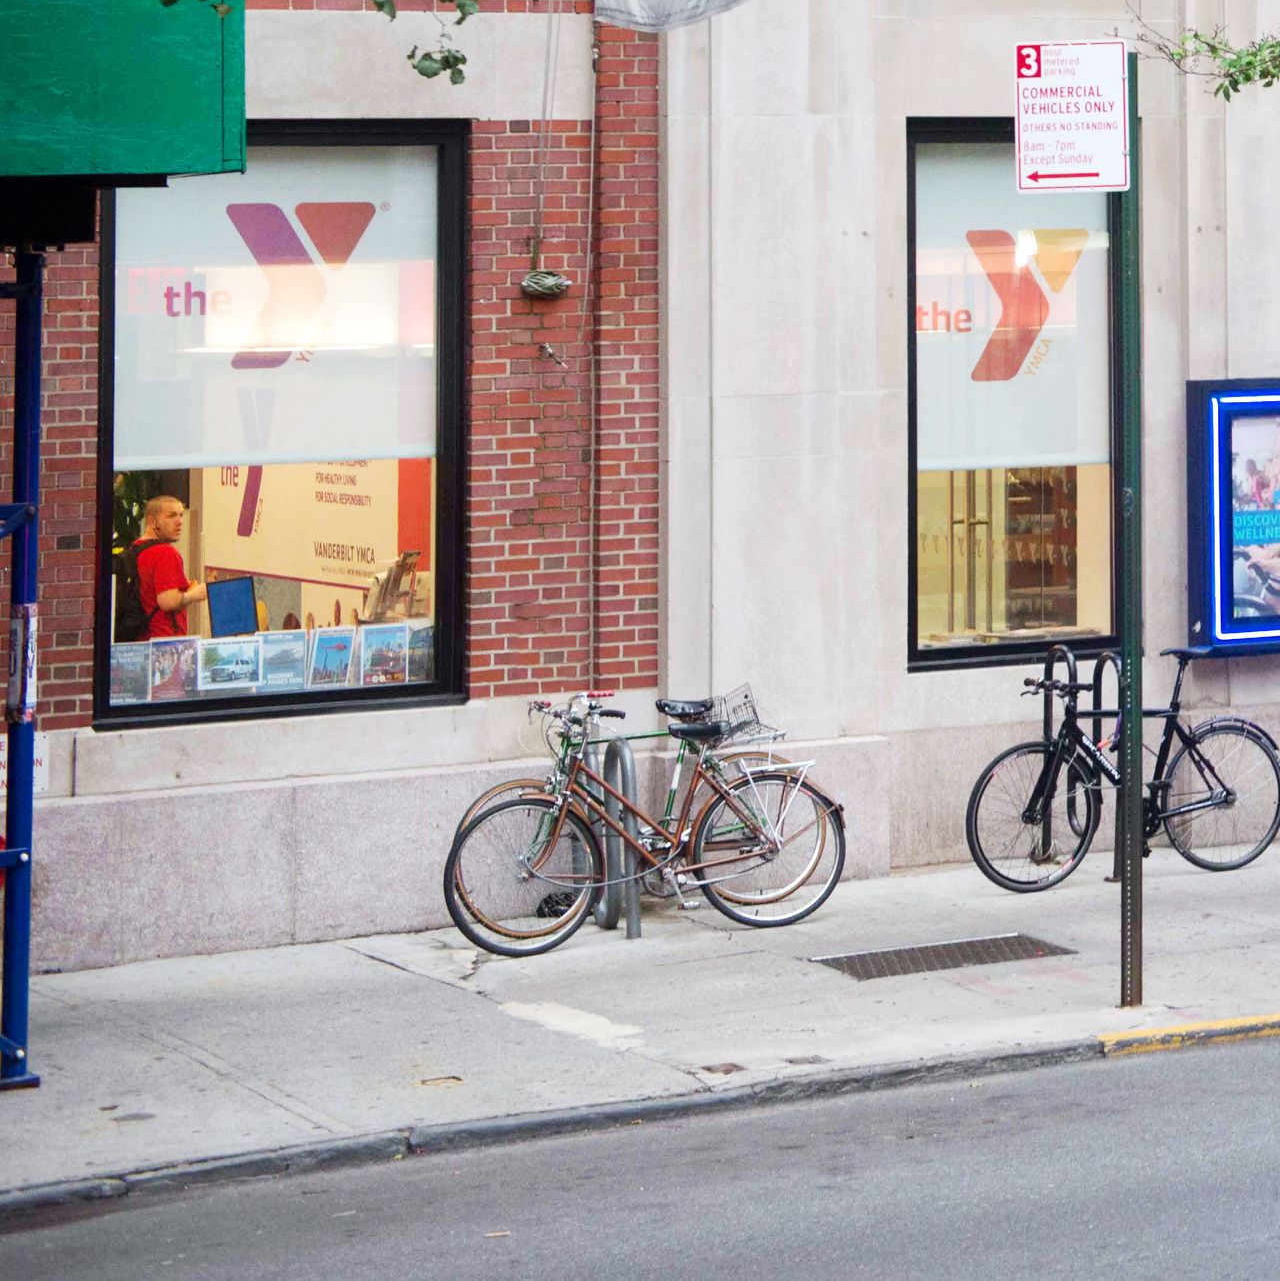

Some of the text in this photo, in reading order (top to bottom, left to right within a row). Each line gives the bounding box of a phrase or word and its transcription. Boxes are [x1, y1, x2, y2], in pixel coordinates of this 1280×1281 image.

[1020, 47, 1038, 77] 3
[1044, 57, 1080, 66] metered
[1044, 68, 1076, 76] parking
[1022, 86, 1102, 99] COMMERCIAL
[1023, 101, 1115, 115] VEHICLES ONLY
[1022, 121, 1118, 132] OTHERS NO STANDING
[1023, 141, 1045, 151] 8am
[1055, 140, 1076, 152] 7pm
[1023, 153, 1093, 166] Except Sunday
[164, 281, 232, 317] the
[916, 301, 972, 333] the
[1024, 337, 1053, 376] YMCA
[324, 473, 342, 485] HEALTHY
[343, 475, 357, 486] LIVING
[324, 492, 338, 504] SOCIAL
[339, 493, 371, 507] RESPONSIBILITY
[314, 542, 375, 564] VANDERBILT YMCA
